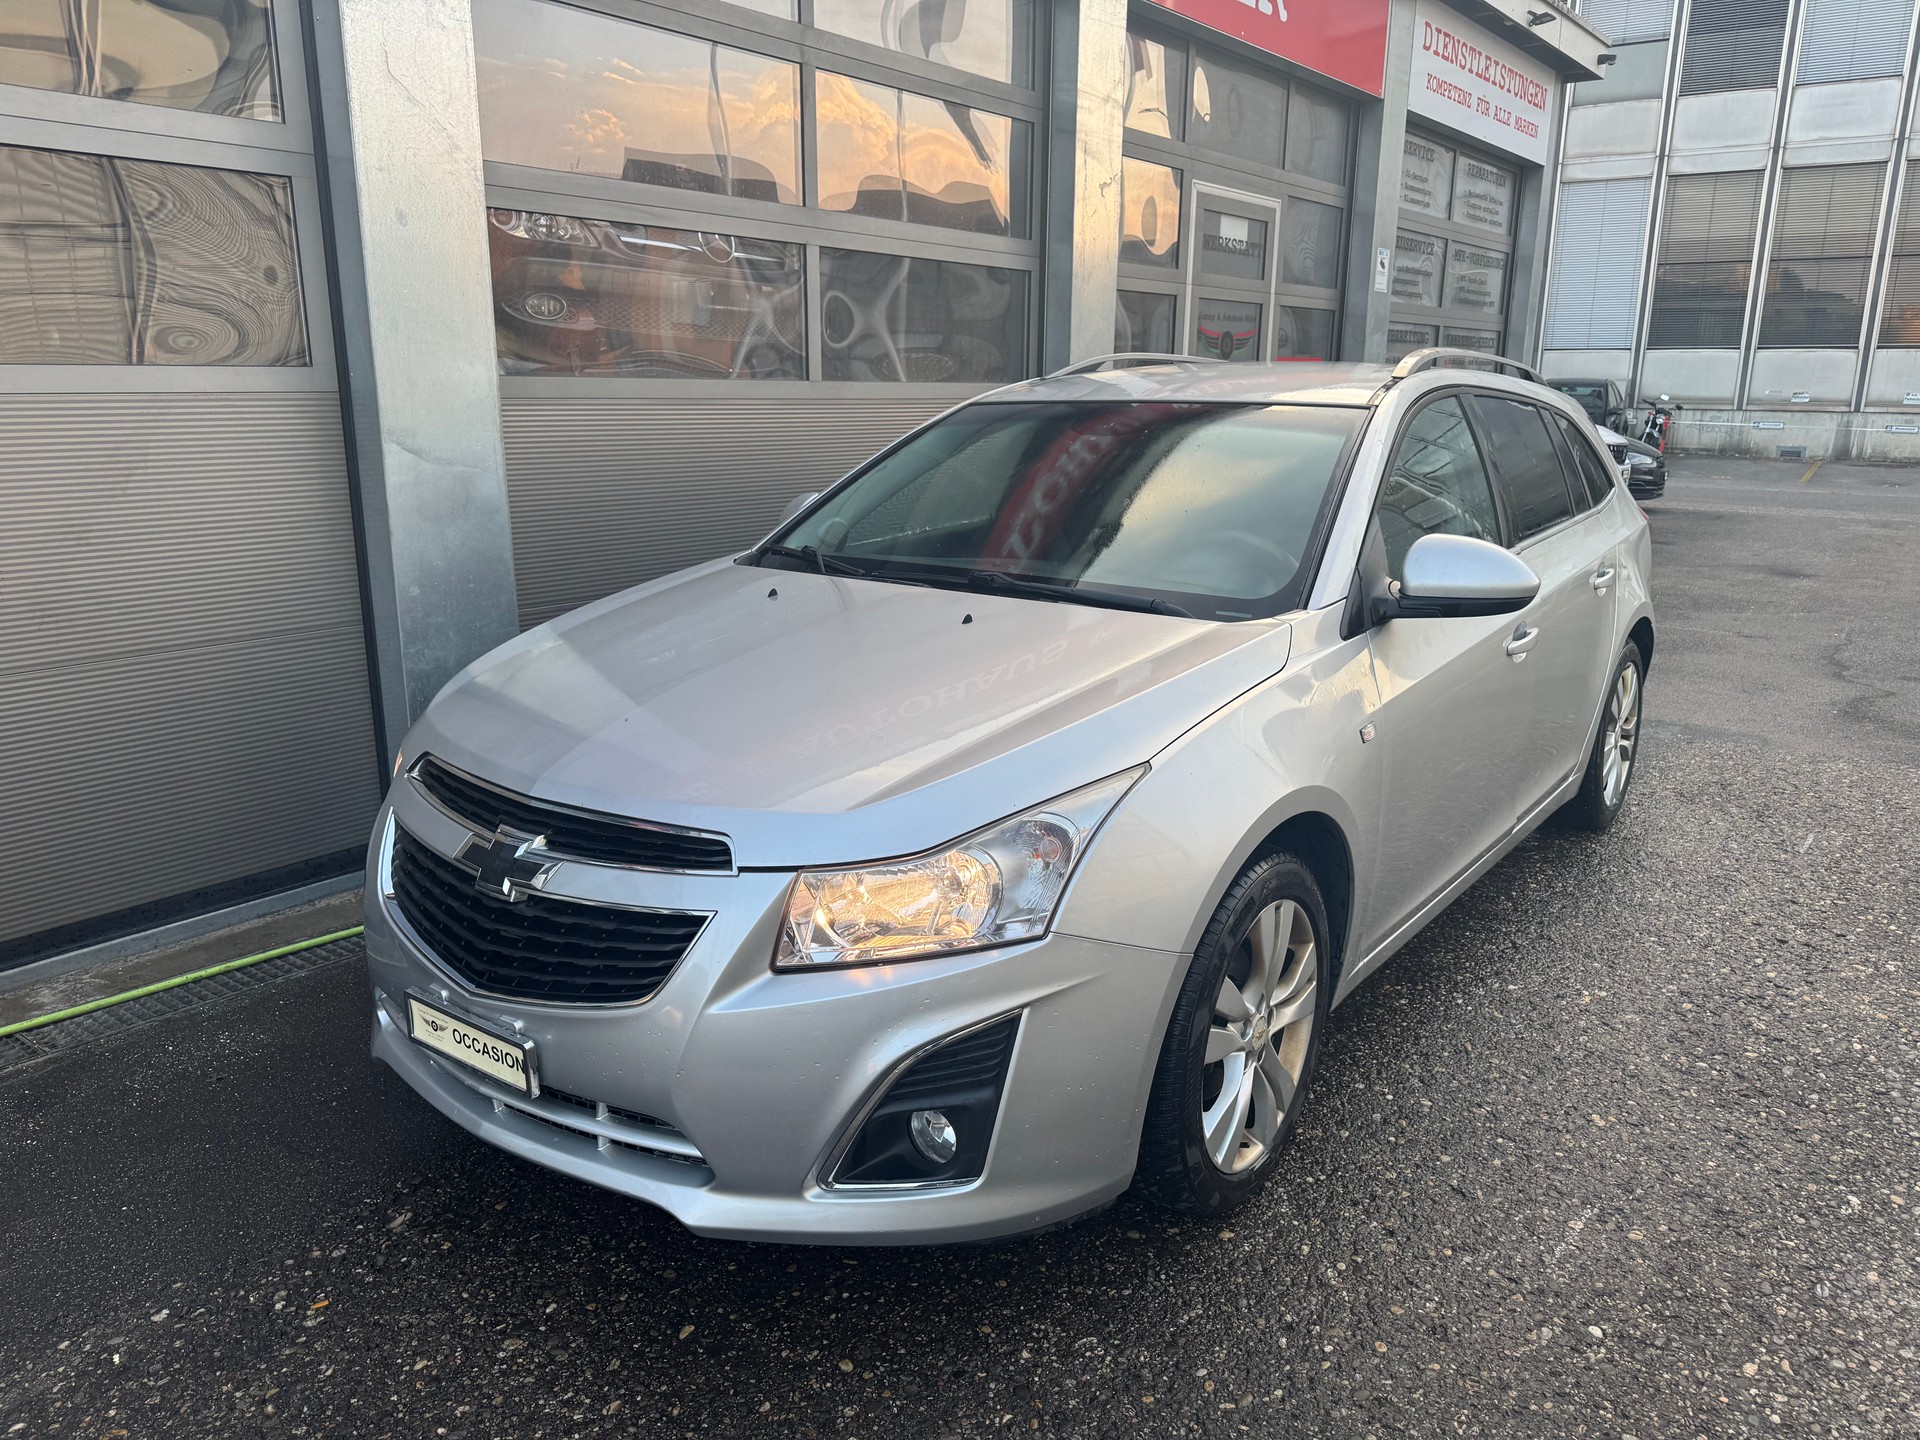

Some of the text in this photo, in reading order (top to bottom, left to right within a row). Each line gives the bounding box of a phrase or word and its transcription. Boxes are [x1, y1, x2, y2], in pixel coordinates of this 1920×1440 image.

[1423, 21, 1548, 112] DIENSTLEISTUNGEN
[1426, 73, 1539, 139] KOMPETENZ FÜR ALLE MARKEN
[1404, 140, 1435, 162] SERVICE
[1203, 233, 1262, 257] WERKSTATT
[453, 1028, 525, 1074] OCCASION
